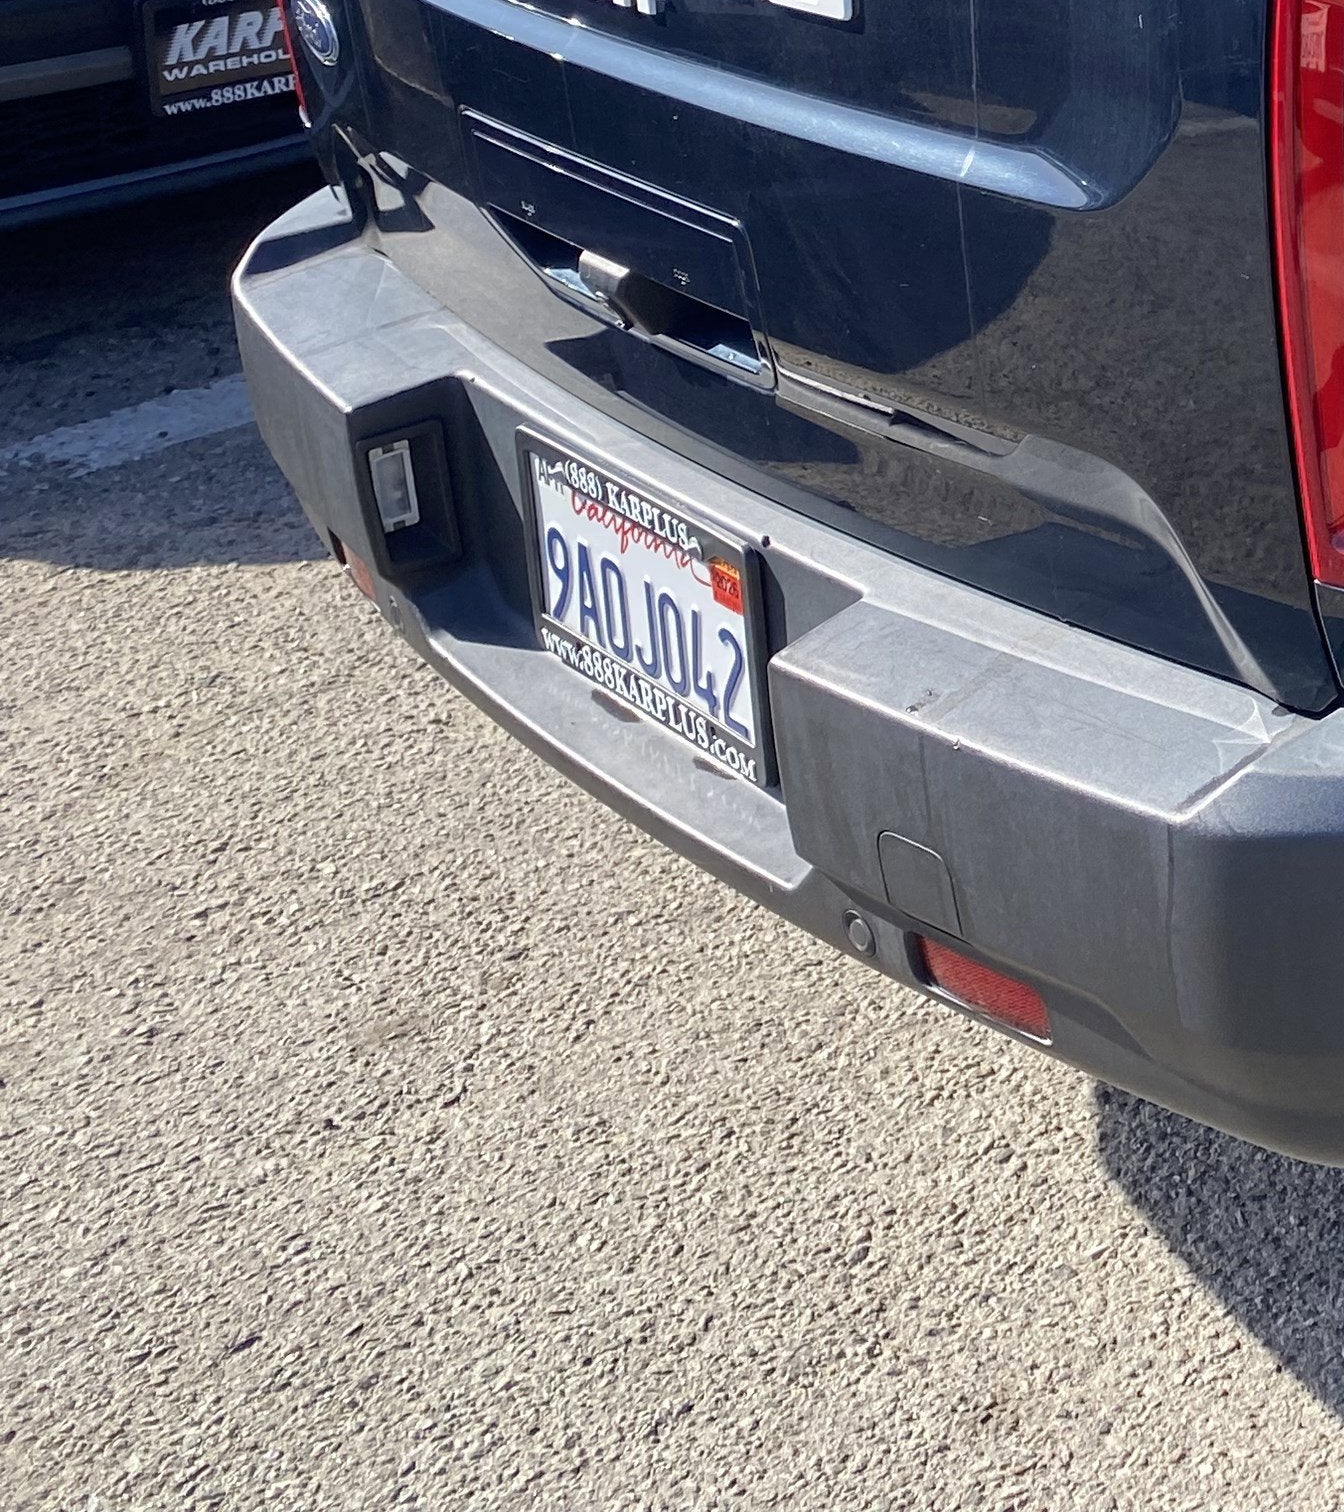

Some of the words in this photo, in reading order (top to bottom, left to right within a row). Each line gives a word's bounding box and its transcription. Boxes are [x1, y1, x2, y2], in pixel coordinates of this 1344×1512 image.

[565, 459, 602, 500] (888)
[606, 482, 690, 551] KARPLUS
[541, 626, 758, 782] www.888KARPLUS.COM
